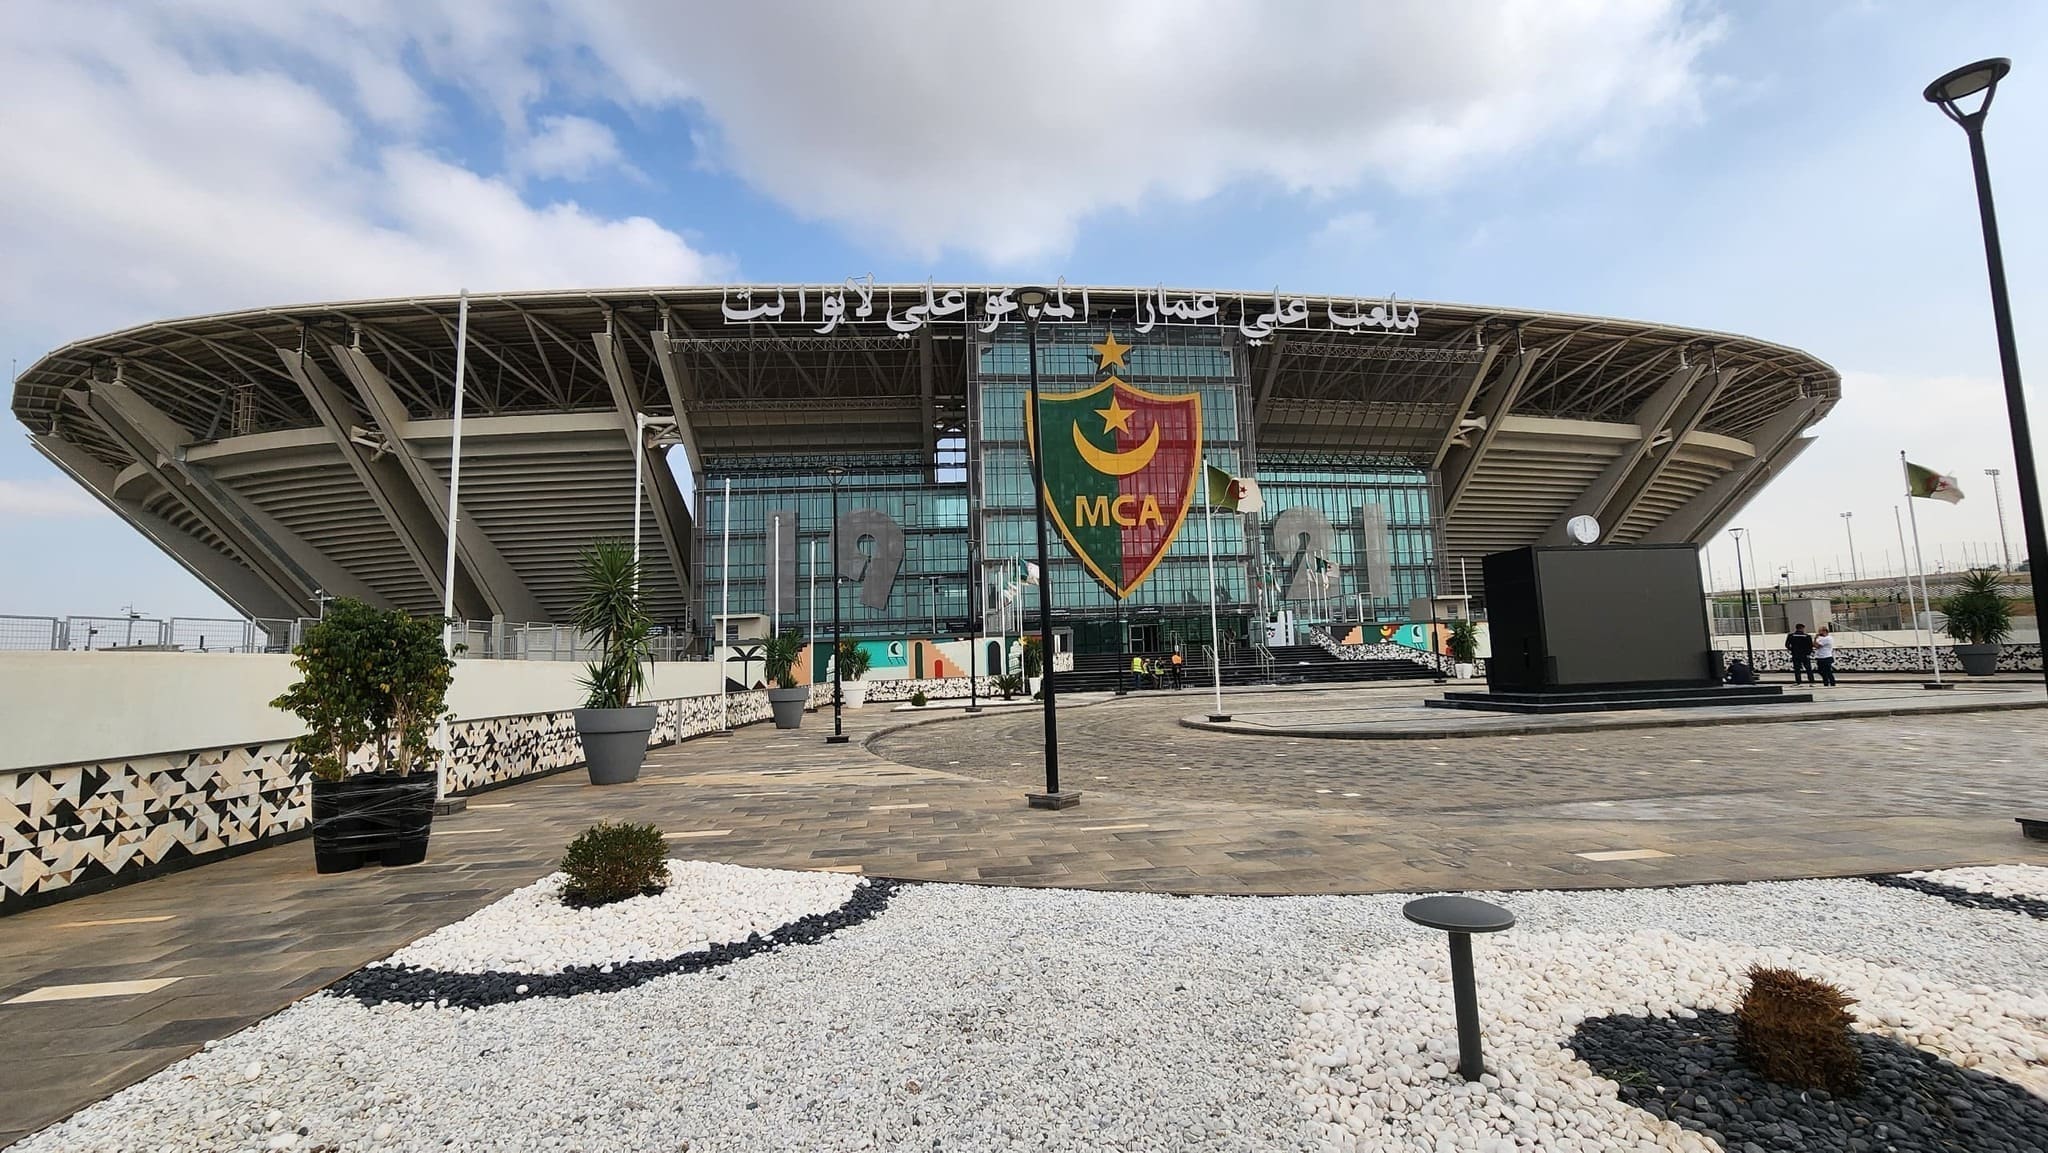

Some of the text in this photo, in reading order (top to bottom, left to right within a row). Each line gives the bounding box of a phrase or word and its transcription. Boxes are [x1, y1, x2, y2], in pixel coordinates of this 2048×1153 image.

[886, 275, 966, 339] علي
[1135, 281, 1220, 333] عمار
[1239, 284, 1310, 346] علي
[1328, 292, 1419, 335] ملعب
[1075, 495, 1165, 527] MCA
